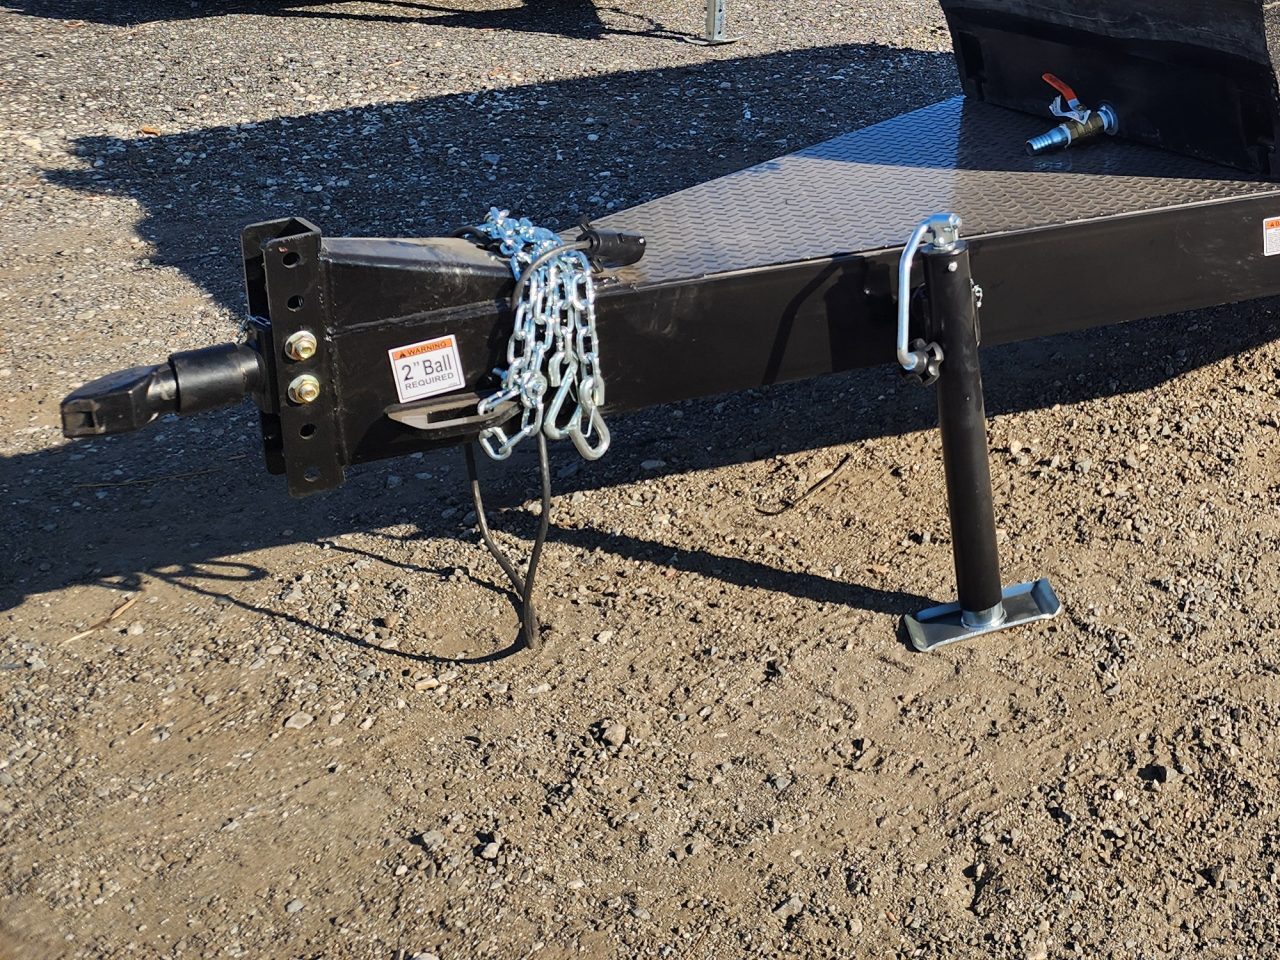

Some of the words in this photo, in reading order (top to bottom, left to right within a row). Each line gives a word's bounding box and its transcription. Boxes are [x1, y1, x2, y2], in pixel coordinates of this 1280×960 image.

[407, 341, 447, 355] WARNING
[422, 354, 452, 375] Ball
[405, 372, 454, 390] REQUIRED
